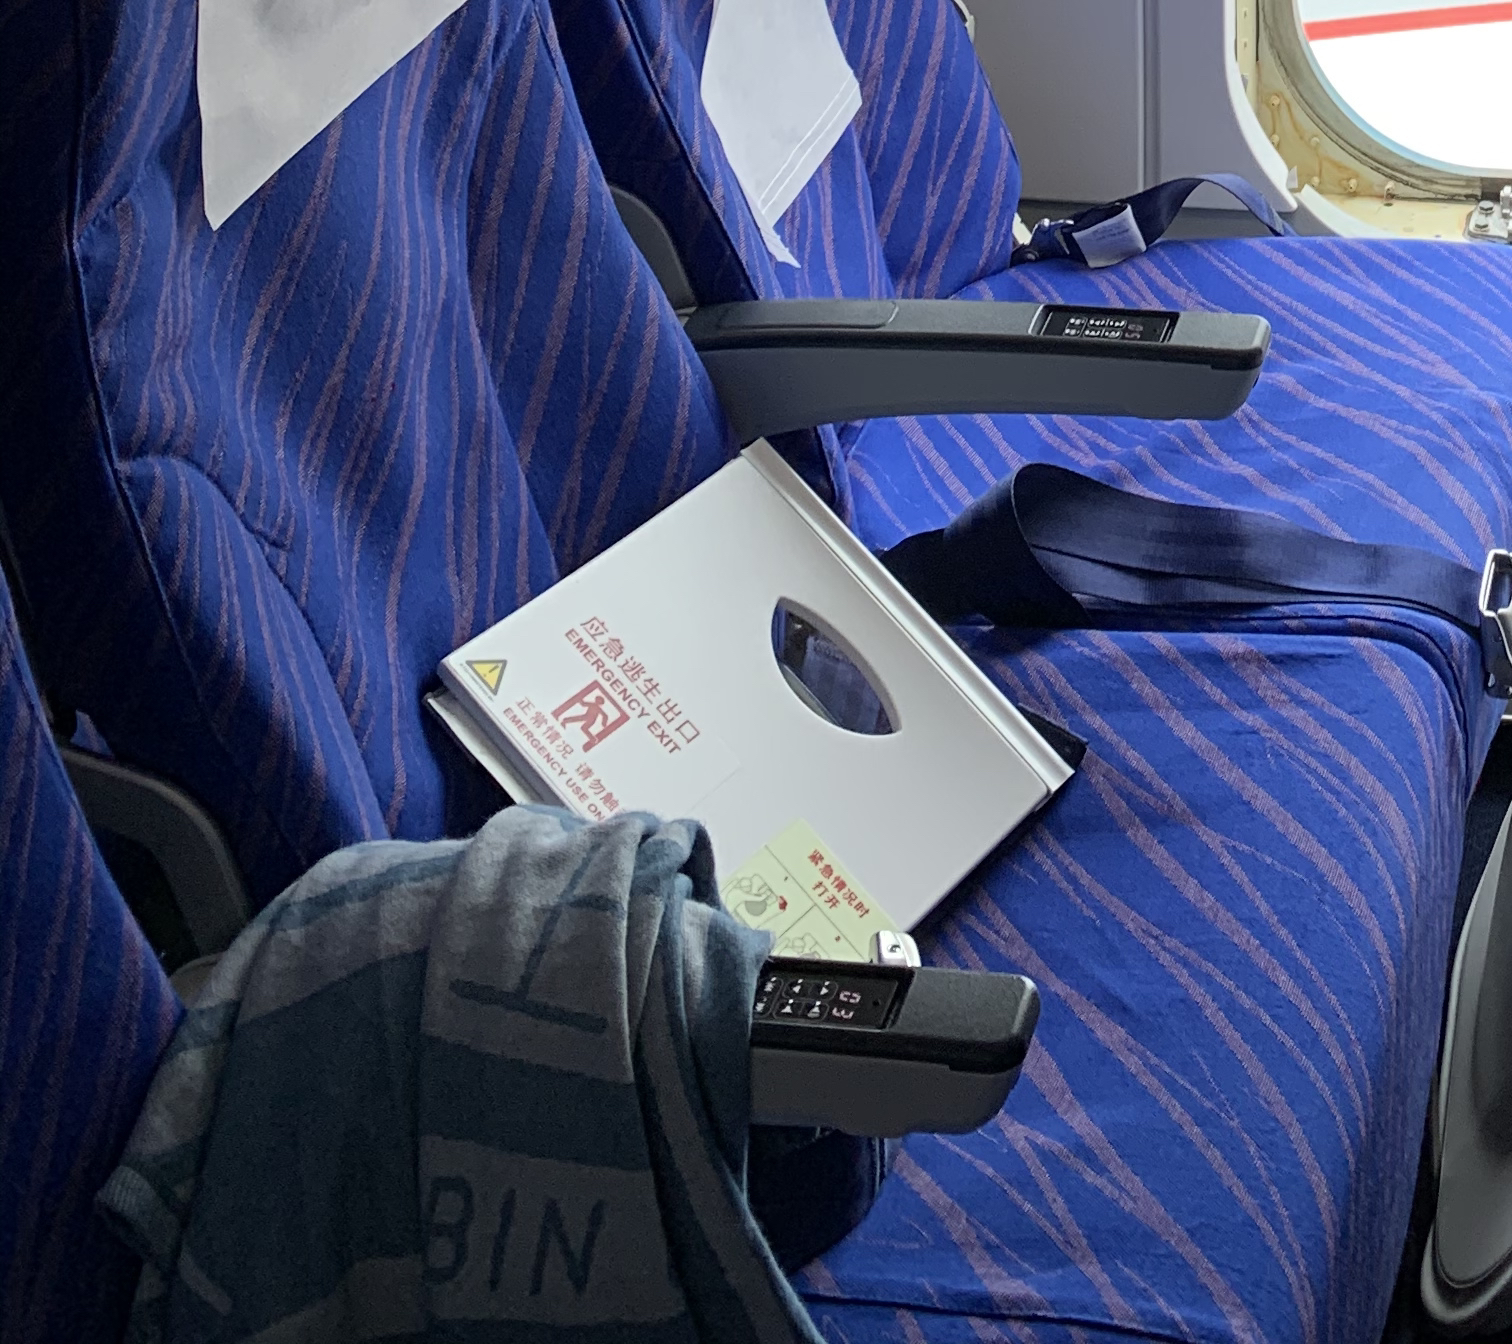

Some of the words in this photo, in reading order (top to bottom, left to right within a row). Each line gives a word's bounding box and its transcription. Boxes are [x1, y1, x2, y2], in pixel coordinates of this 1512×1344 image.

[564, 628, 650, 721] EMERGENCY
[647, 721, 682, 754] EXIT
[579, 615, 701, 744] 应急逃生出口
[503, 707, 568, 777] EMERGENCY
[565, 778, 589, 803] USE
[587, 802, 606, 822] ON
[515, 696, 574, 761] 正常情况
[575, 762, 621, 812] 请勿触
[807, 848, 870, 919] 紧急情况时
[812, 880, 841, 909] 打开
